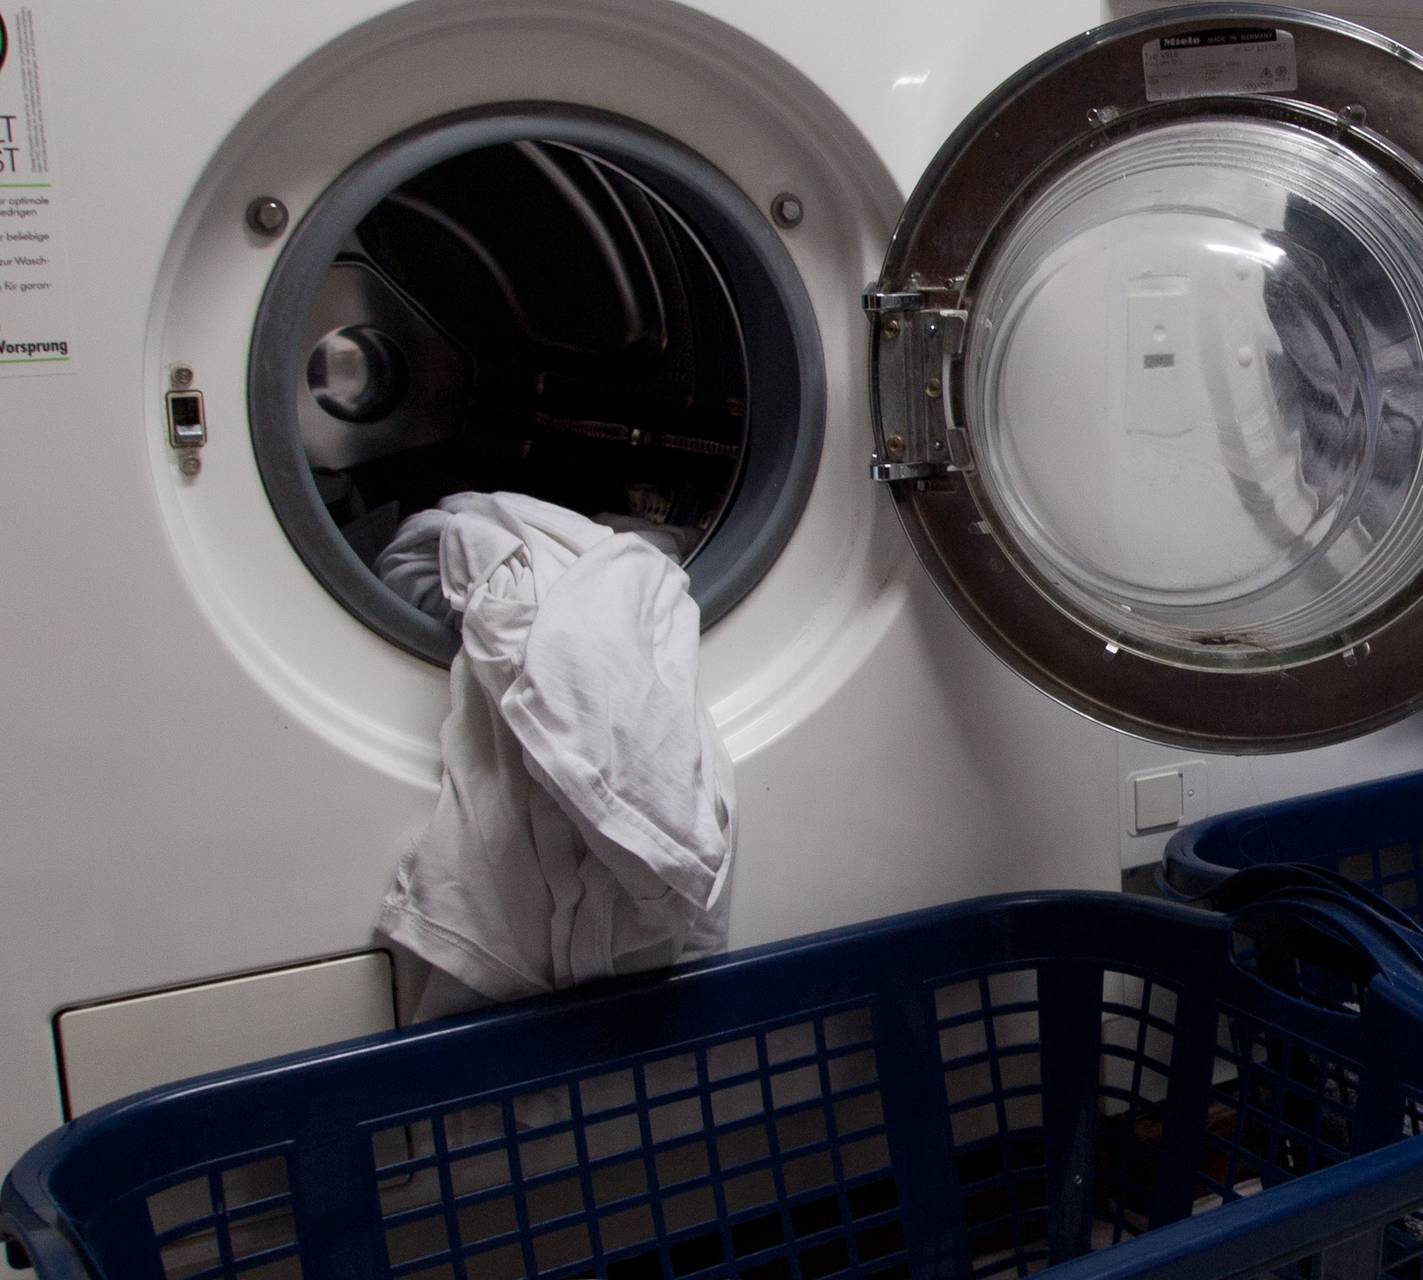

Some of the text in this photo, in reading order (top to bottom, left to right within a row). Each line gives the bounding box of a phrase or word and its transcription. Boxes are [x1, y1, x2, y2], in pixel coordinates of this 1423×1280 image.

[1163, 37, 1200, 47] Miele
[1240, 32, 1273, 41] GERMANY
[8, 196, 49, 208] optimale
[6, 232, 50, 243] beliebige
[14, 256, 51, 266] Wasch-
[4, 281, 18, 291] für
[0, 340, 68, 356] Vorsprung
